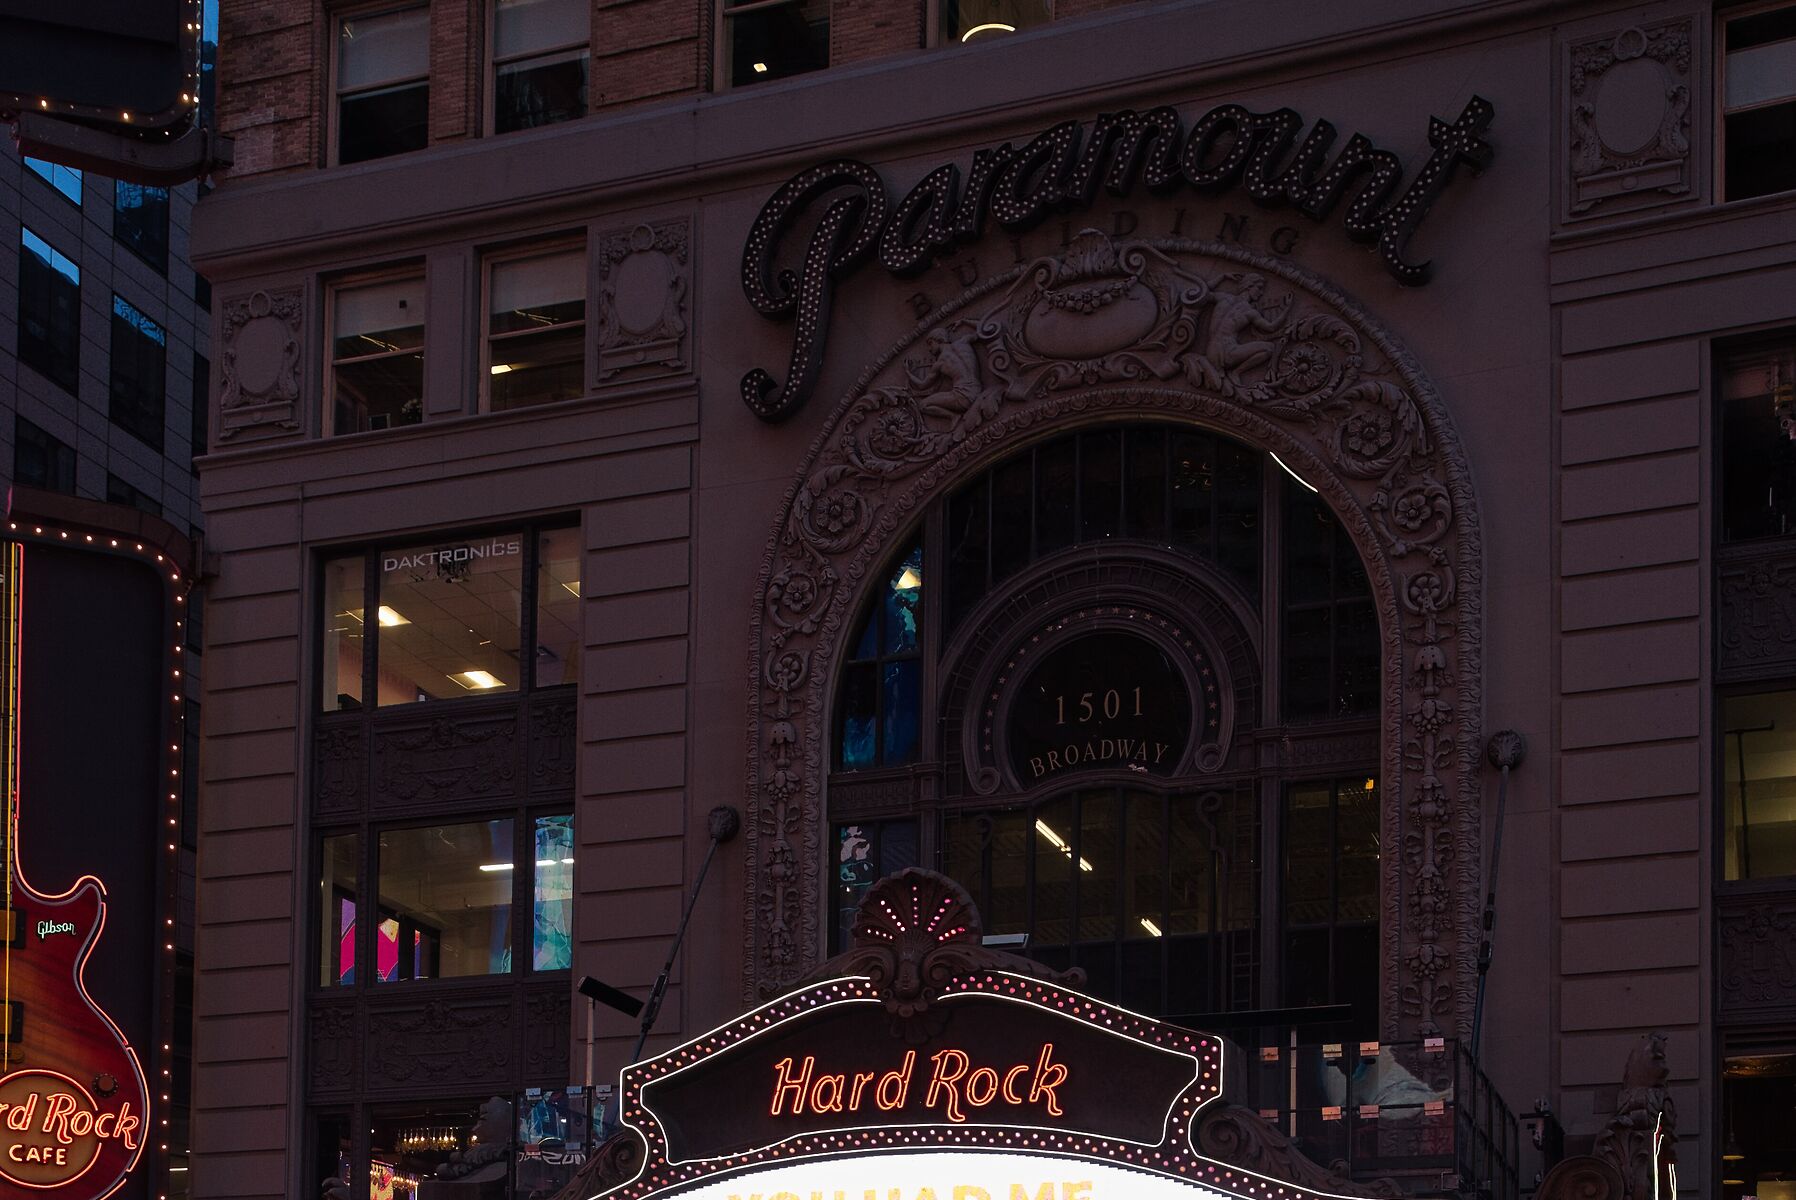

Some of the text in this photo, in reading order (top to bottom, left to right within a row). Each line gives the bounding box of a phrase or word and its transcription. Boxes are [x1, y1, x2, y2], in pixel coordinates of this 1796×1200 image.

[740, 94, 1495, 424] Paramount
[384, 540, 520, 572] DAKTRONICS
[1055, 685, 1144, 725] 1501
[1029, 738, 1169, 778] BROADWAY
[37, 919, 77, 939] Gibson
[770, 1043, 1068, 1123] Hard Rock
[42, 1093, 139, 1150] Rock
[8, 1144, 67, 1166] CAFE
